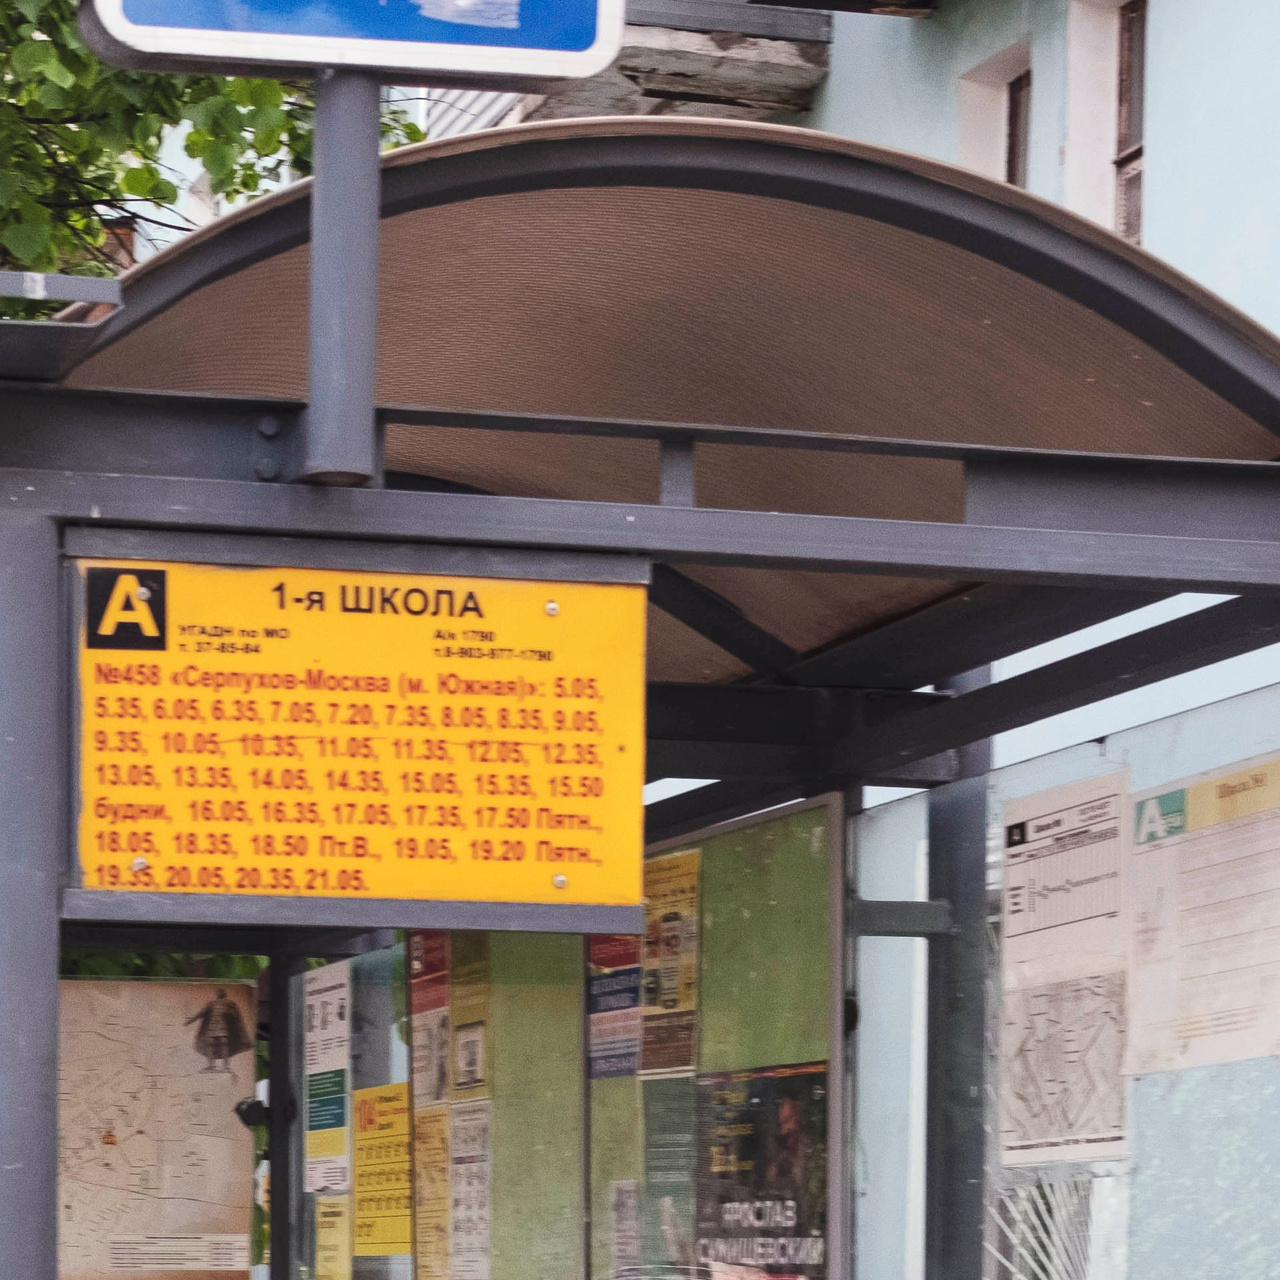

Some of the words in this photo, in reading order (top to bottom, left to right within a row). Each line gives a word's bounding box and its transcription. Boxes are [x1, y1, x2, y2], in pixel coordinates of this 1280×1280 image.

[98, 574, 161, 637] А
[270, 581, 327, 612] 1-я
[339, 584, 485, 619] ШКОЛА
[238, 629, 259, 638] по
[262, 628, 290, 639] МО
[94, 663, 162, 686] №458
[169, 665, 391, 694] «Серпухов-Москва
[398, 674, 429, 699] (м.
[554, 677, 603, 700] 5.05,
[94, 696, 148, 721] 5.35,
[153, 698, 206, 723] 6.05,
[211, 699, 264, 724] 6.35,
[270, 701, 322, 725] 7.05,
[327, 703, 378, 726] 7.20,
[384, 704, 436, 730] 7.35,
[441, 706, 492, 730] 8.05,
[497, 707, 548, 731] 8.35,
[553, 710, 603, 733] 9.05,
[93, 730, 148, 755] 9.35,
[161, 732, 229, 757] 10.05,
[238, 733, 307, 758] 10.35,
[315, 736, 379, 761] 11.05,
[392, 738, 457, 763] 11.35,
[464, 740, 532, 766] 12.05,
[539, 742, 603, 766] 12.35,
[95, 764, 161, 789] 13.05,
[172, 766, 237, 791] 13.35,
[249, 768, 313, 792] 14.05,
[325, 770, 389, 795] 14.35,
[400, 772, 463, 797] 15.05,
[474, 774, 537, 798] 15.35,
[548, 776, 603, 798] 15.50
[93, 796, 172, 825] будни,
[188, 799, 253, 824] 16.05,
[260, 801, 325, 827] 16.35,
[332, 803, 396, 827] 17.05,
[403, 805, 467, 829] 17.35,
[474, 806, 531, 829] 17.50
[536, 807, 602, 831] Пятн.,
[94, 830, 161, 857] 18.05,
[173, 832, 238, 858] 18.35,
[250, 834, 309, 857] 18.50
[319, 835, 382, 861] Пт.В.,
[394, 837, 457, 862] 19.05,
[469, 839, 526, 862] 19.20
[536, 840, 602, 865] Пятн.,
[94, 863, 162, 890] 19.35,
[165, 865, 231, 893] 20.05,
[235, 867, 301, 894] 20.35,
[304, 868, 370, 892] 21.05.
